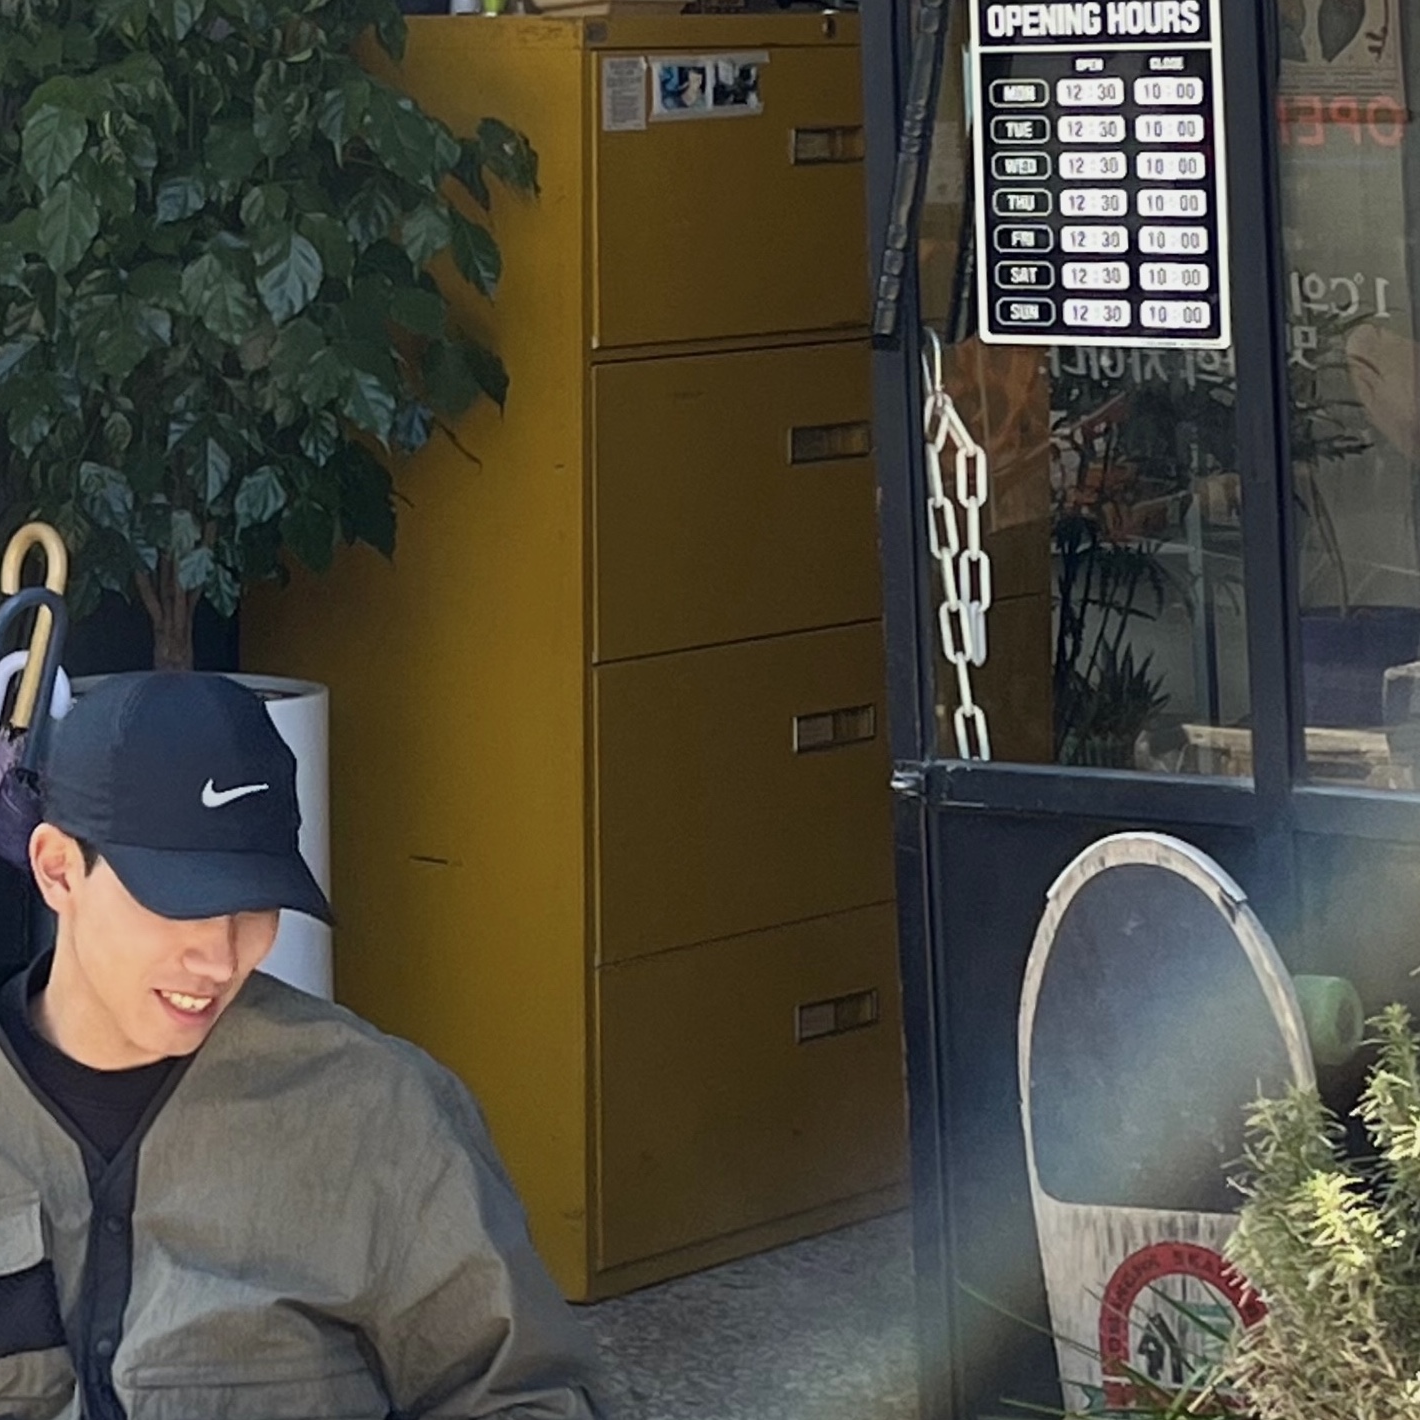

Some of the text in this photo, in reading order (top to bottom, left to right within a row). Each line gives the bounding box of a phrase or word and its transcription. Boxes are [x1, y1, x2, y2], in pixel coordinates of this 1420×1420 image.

[987, 1, 1201, 37] OPENING HOURS
[1005, 122, 1033, 138] TUE
[1005, 158, 1037, 174] WED
[1007, 195, 1035, 211] THU
[1010, 267, 1038, 283] SAT
[1010, 304, 1040, 320] SUN
